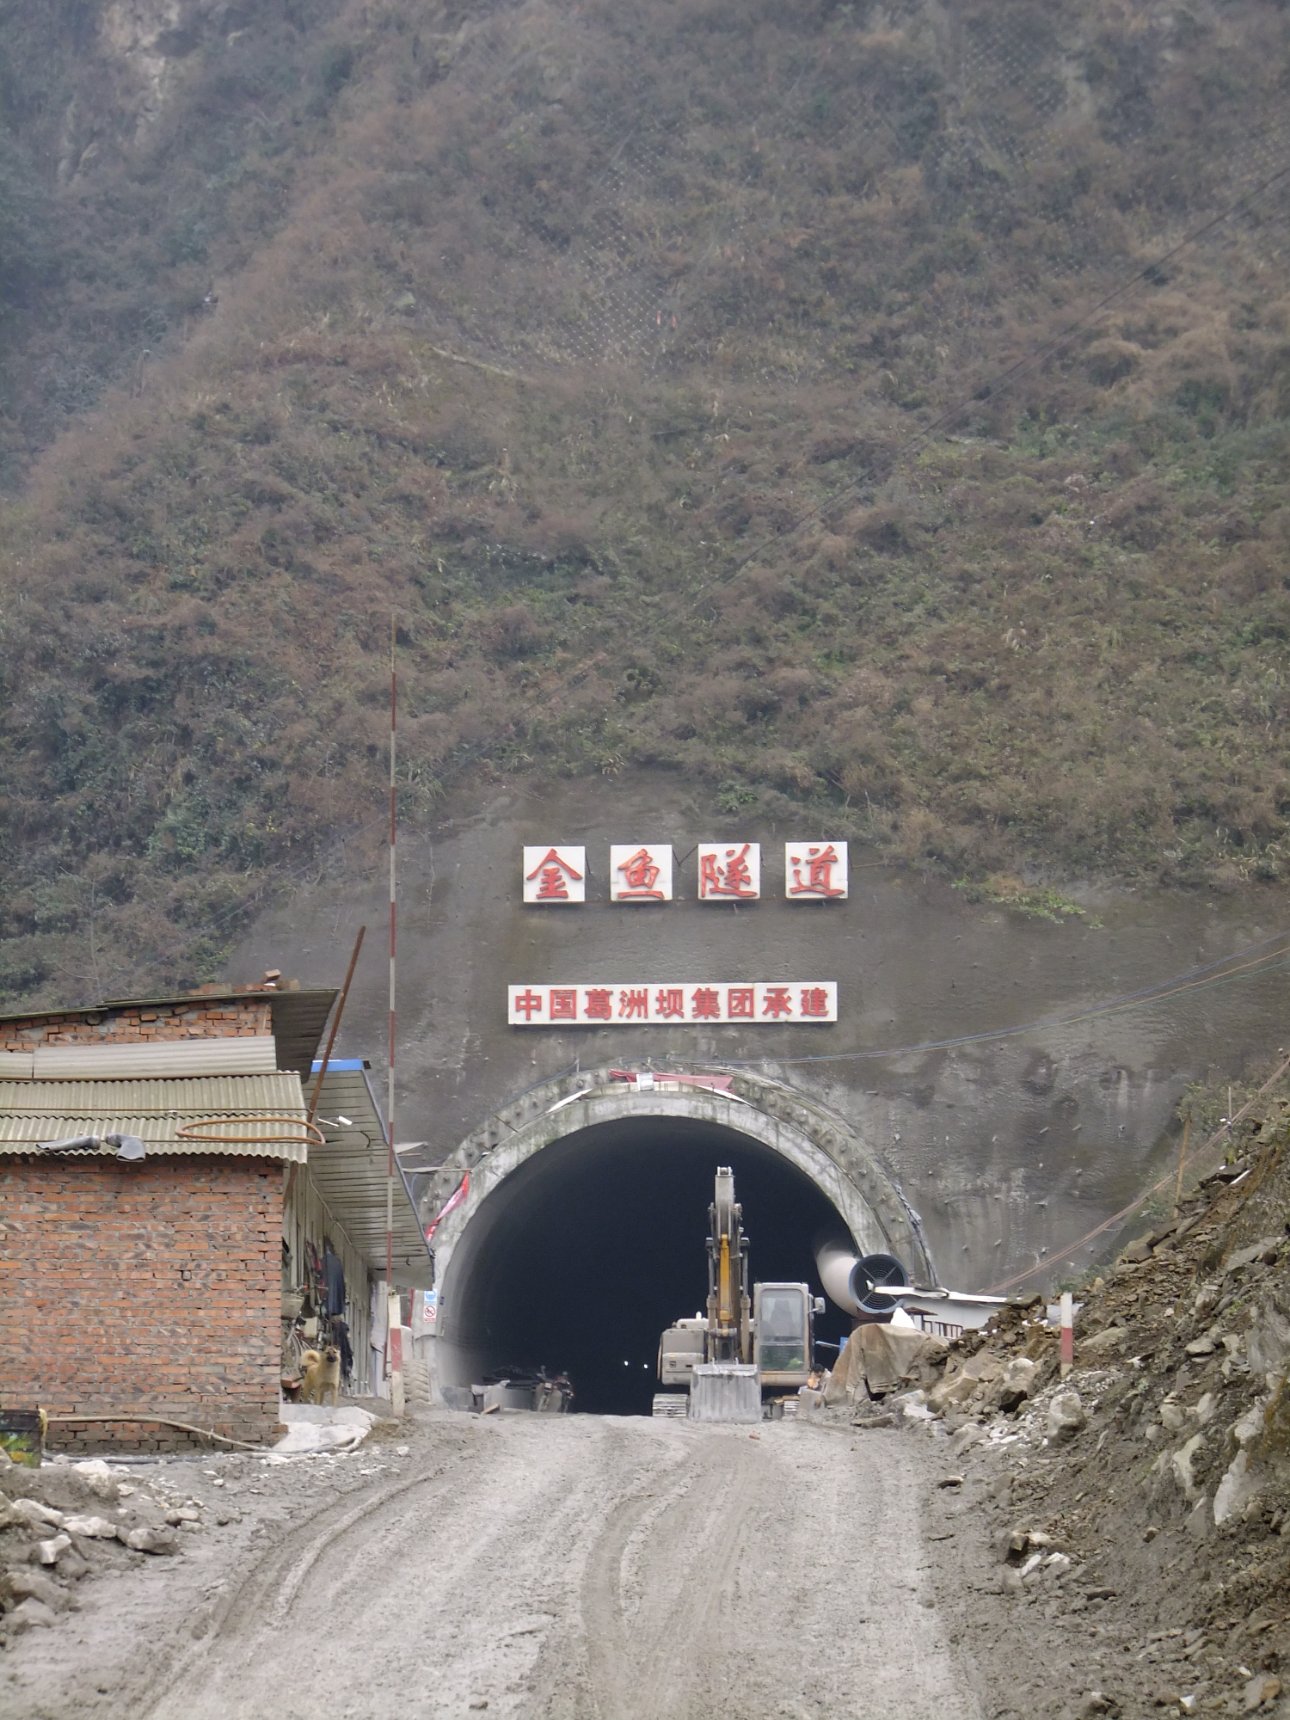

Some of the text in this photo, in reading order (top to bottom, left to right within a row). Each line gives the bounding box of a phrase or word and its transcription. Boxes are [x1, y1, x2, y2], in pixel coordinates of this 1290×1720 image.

[526, 843, 845, 899] 金鱼隧道
[514, 987, 829, 1020] 中国葛洲坝集团承建
